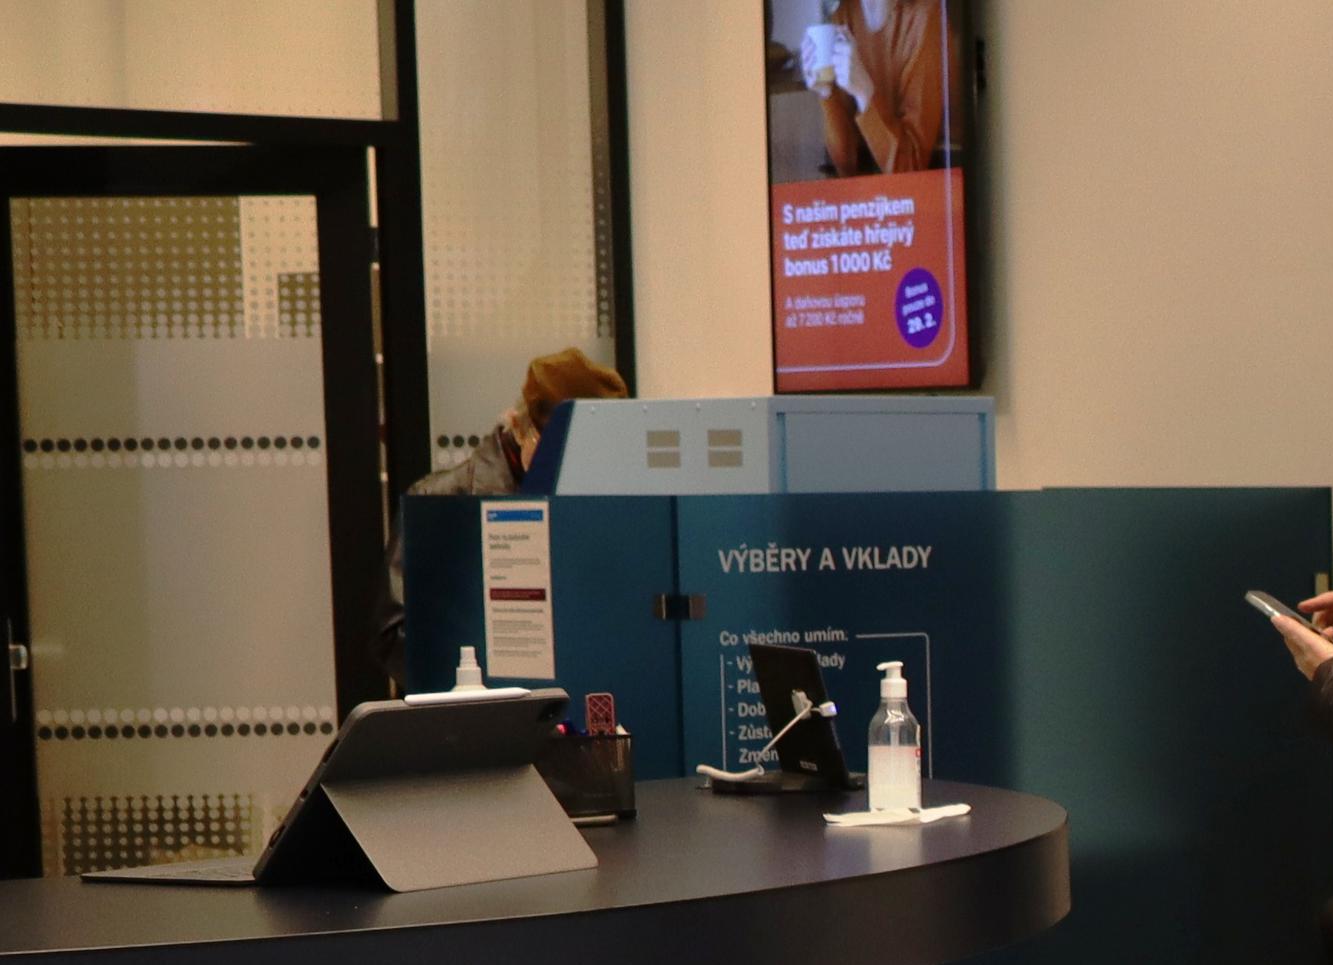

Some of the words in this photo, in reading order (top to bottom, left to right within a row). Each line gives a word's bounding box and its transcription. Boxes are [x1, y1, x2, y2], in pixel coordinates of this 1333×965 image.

[783, 204, 794, 224] S
[840, 196, 915, 223] penzijkem
[811, 225, 862, 248] získáte
[784, 257, 828, 276] bonus
[872, 249, 892, 271] Kč
[718, 542, 811, 573] VÝBĚRY
[819, 547, 836, 571] A
[842, 546, 932, 570] VKLADY
[719, 630, 738, 646] Co
[743, 627, 800, 645] všechno
[816, 653, 845, 670] lady
[739, 747, 780, 764] Změn
